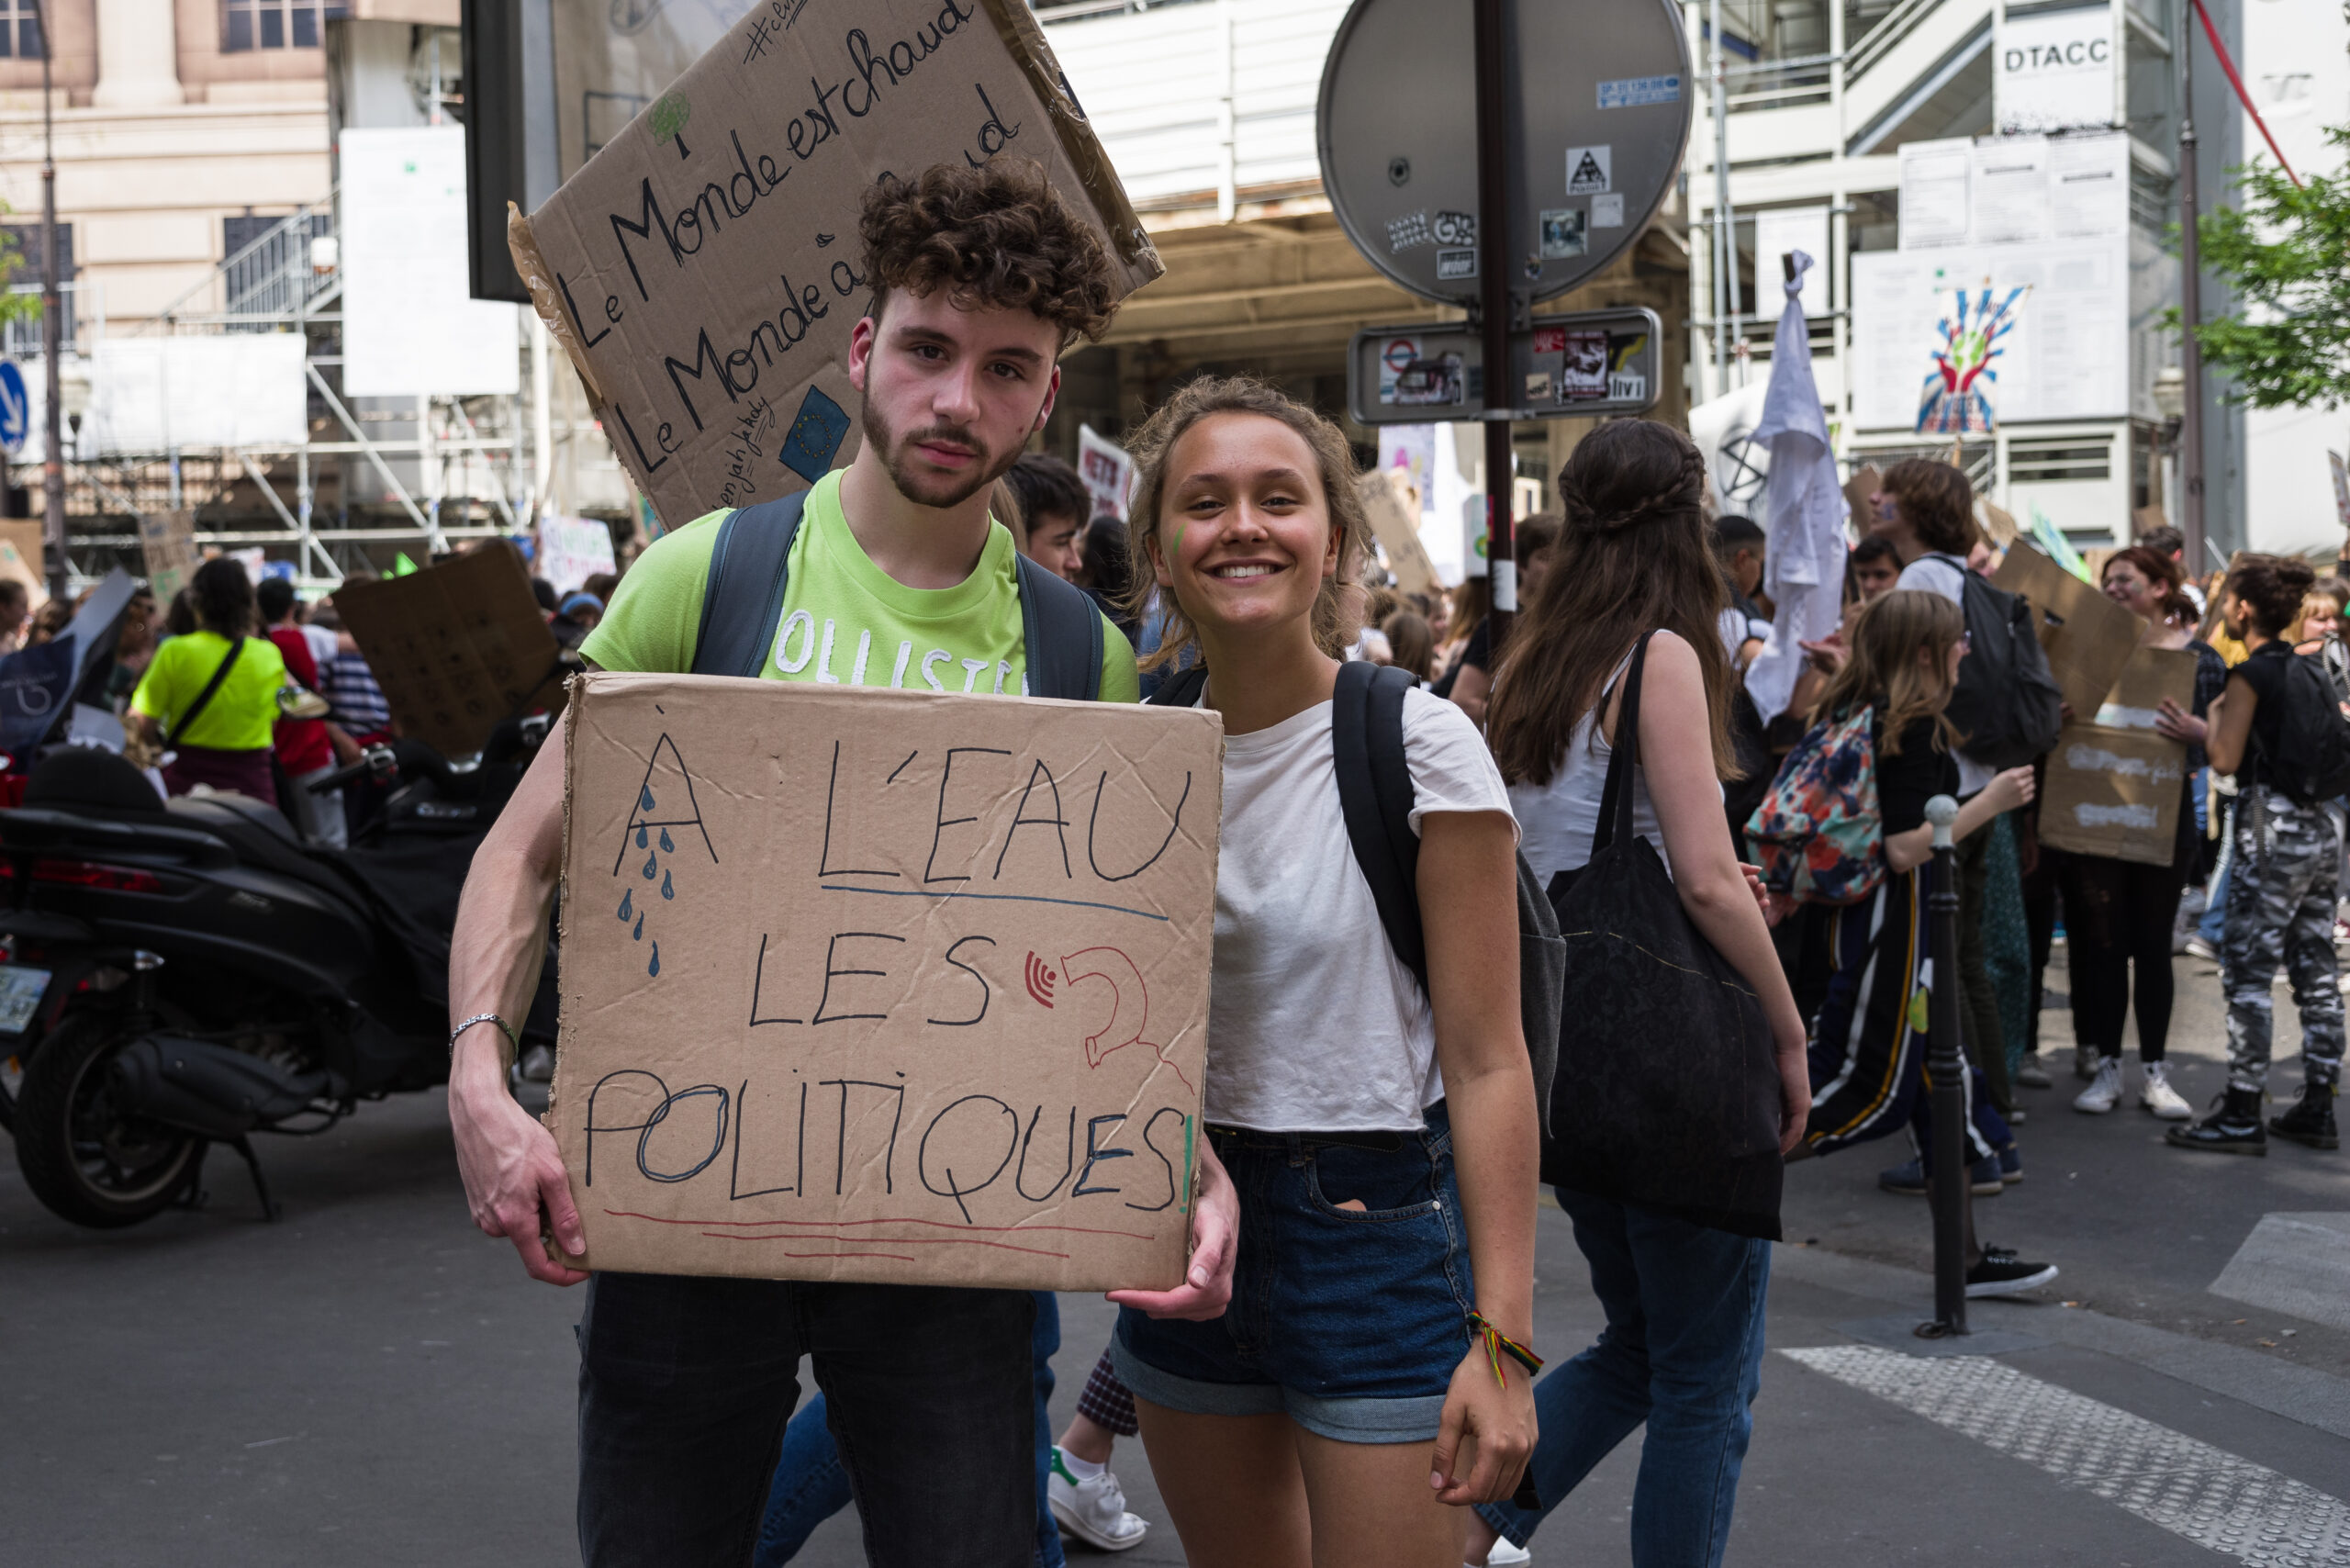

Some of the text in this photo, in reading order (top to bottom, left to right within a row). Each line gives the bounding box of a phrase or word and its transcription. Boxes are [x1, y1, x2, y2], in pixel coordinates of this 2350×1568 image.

[2005, 38, 2109, 73] DTACC
[556, 272, 623, 349] Le
[610, 129, 793, 302] Monde
[786, 76, 846, 162] est
[843, 0, 974, 118] chaud
[615, 402, 683, 474] Le
[664, 274, 831, 432] Monde
[613, 704, 1192, 885] À L'EAU
[748, 932, 997, 1026] LES
